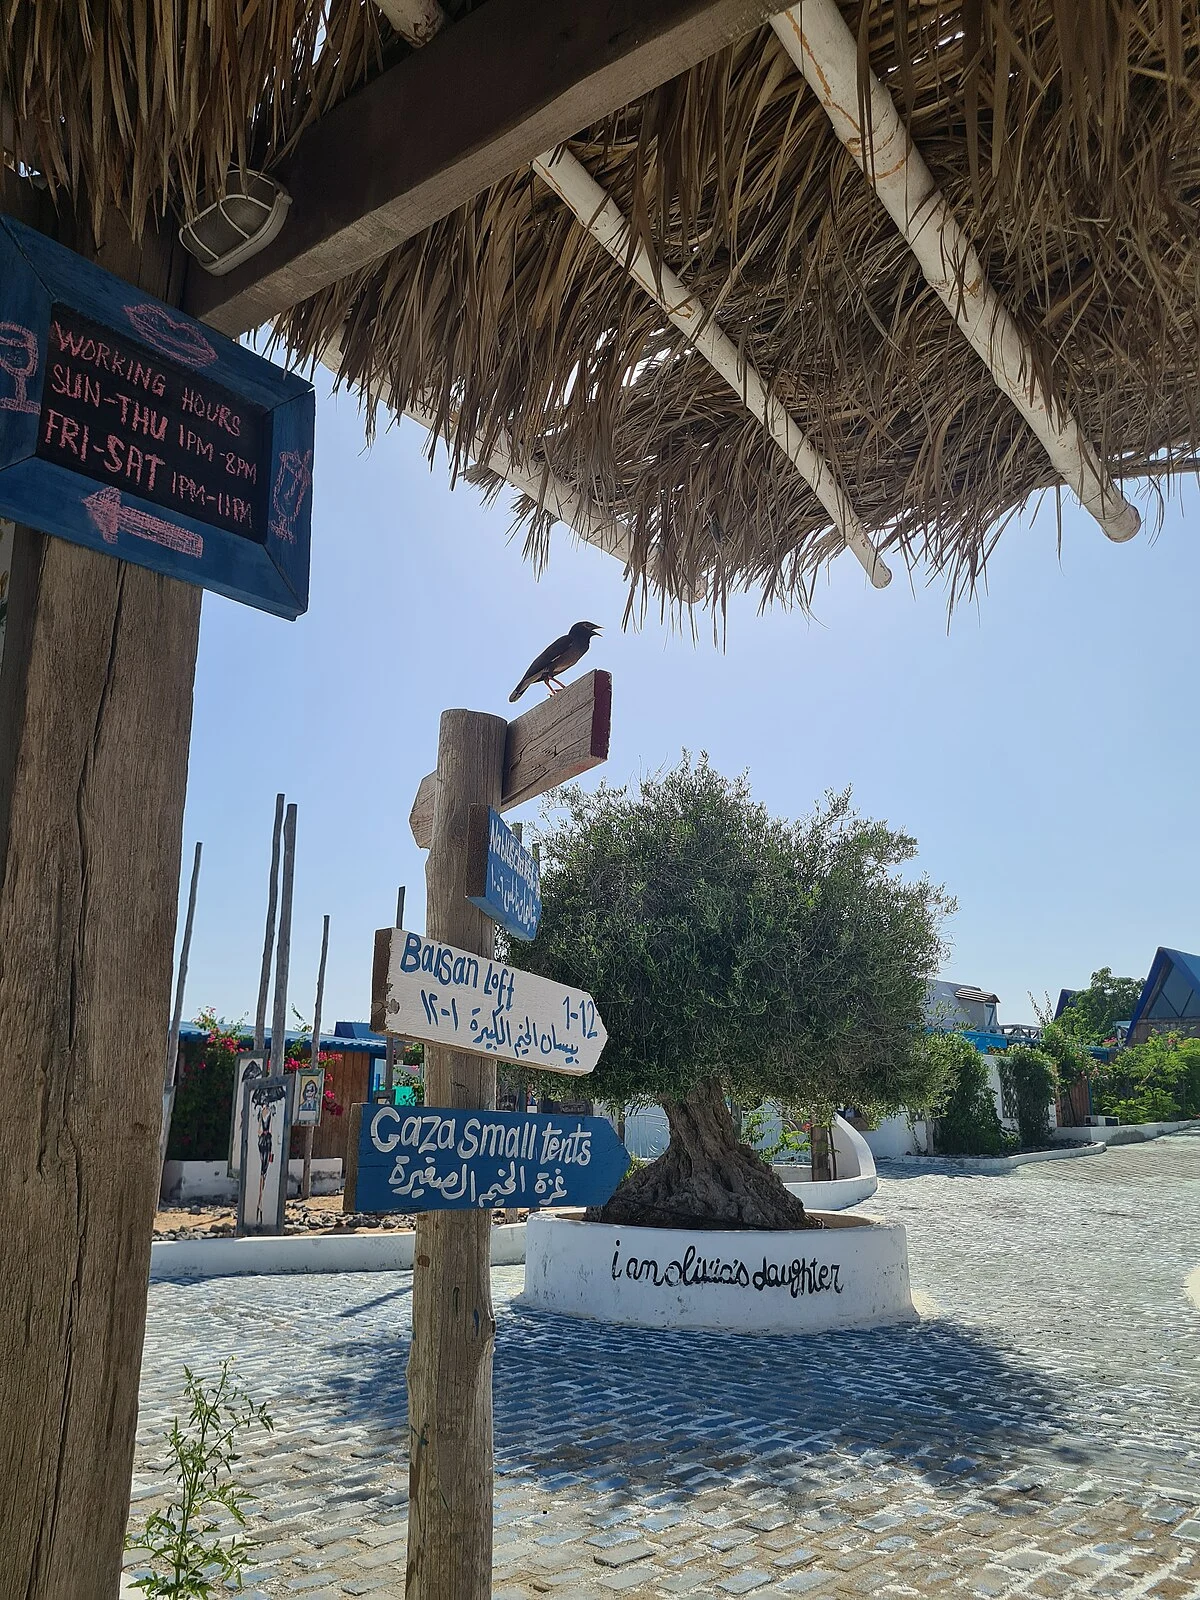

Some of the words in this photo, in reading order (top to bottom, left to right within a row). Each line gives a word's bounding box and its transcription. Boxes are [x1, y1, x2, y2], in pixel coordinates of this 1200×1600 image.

[51, 363, 169, 442] SUN-THU
[52, 320, 167, 397] WORKING
[181, 387, 242, 437] HOURS
[44, 408, 166, 492] FRI-SAT
[400, 932, 478, 988] Baisan
[484, 963, 515, 1011] Loft
[563, 996, 598, 1039] 1-12
[470, 1004, 512, 1051] الكبيرة
[540, 1022, 580, 1064] بيسان
[370, 1107, 456, 1153] Gaza
[539, 1122, 592, 1166] tents
[388, 1155, 476, 1203] الصغيرة
[535, 1168, 568, 1206] غزة
[752, 1256, 844, 1299] daughter
